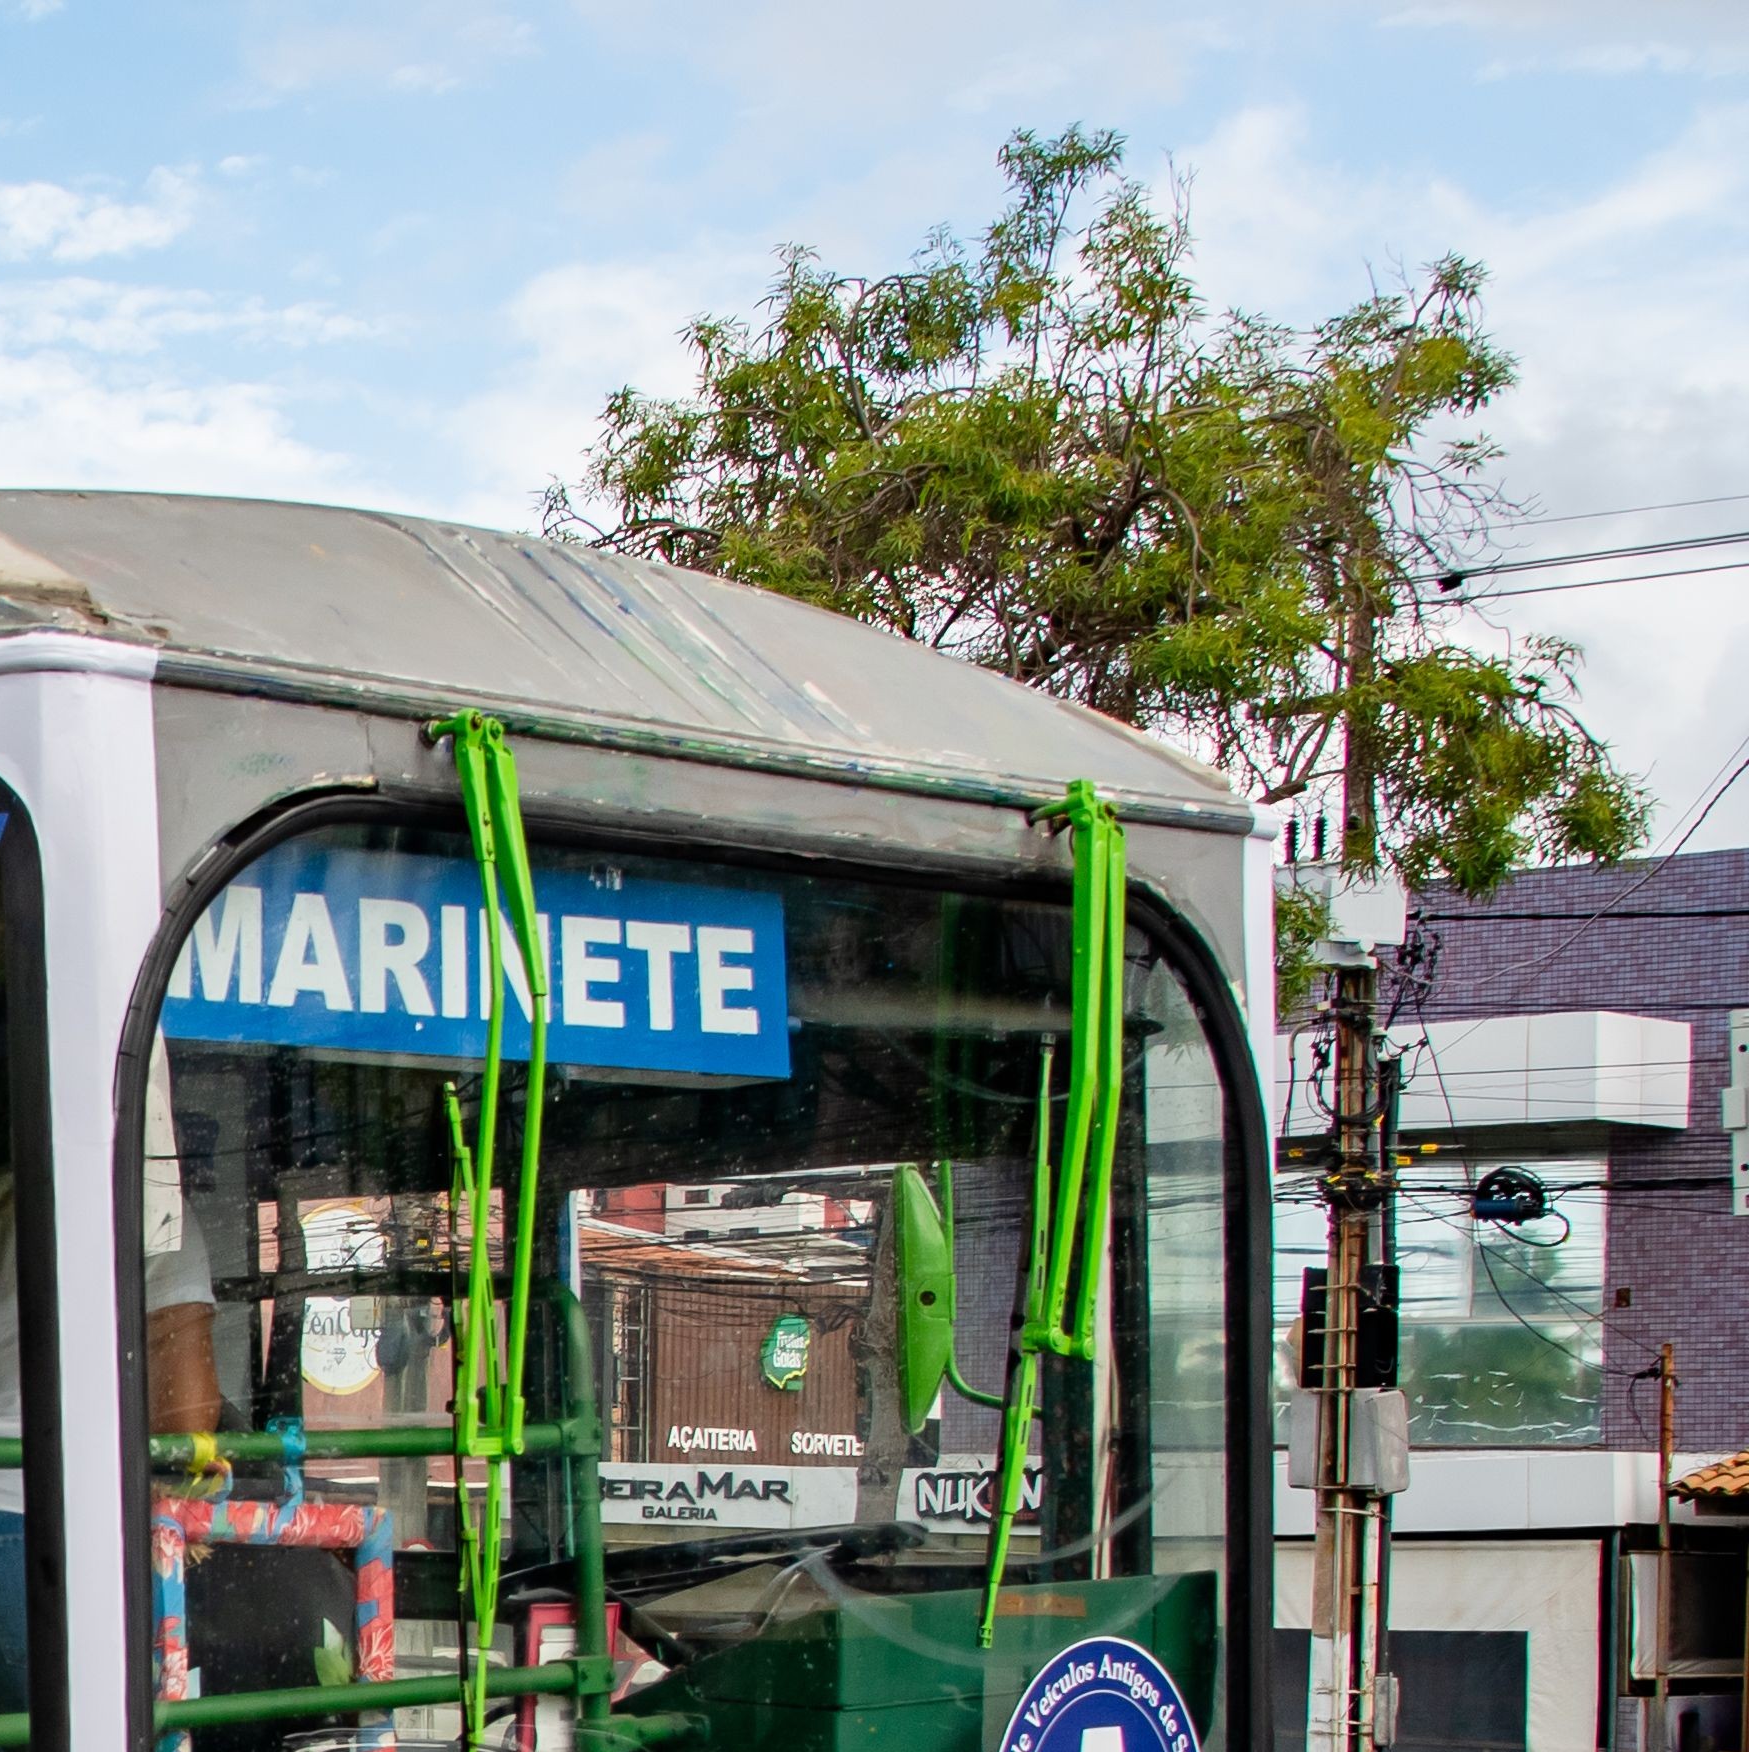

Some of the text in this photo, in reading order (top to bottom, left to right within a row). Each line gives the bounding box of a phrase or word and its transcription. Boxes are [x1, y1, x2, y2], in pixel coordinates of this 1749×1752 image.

[167, 886, 760, 1036] MARINETE
[667, 1425, 757, 1453] AÇAITERIA
[642, 1505, 718, 1521] GALERIA
[918, 1473, 1042, 1519] NUKN
[1024, 1660, 1095, 1728] Veículos
[1097, 1653, 1161, 1707] Antigos
[1158, 1704, 1178, 1737] de
